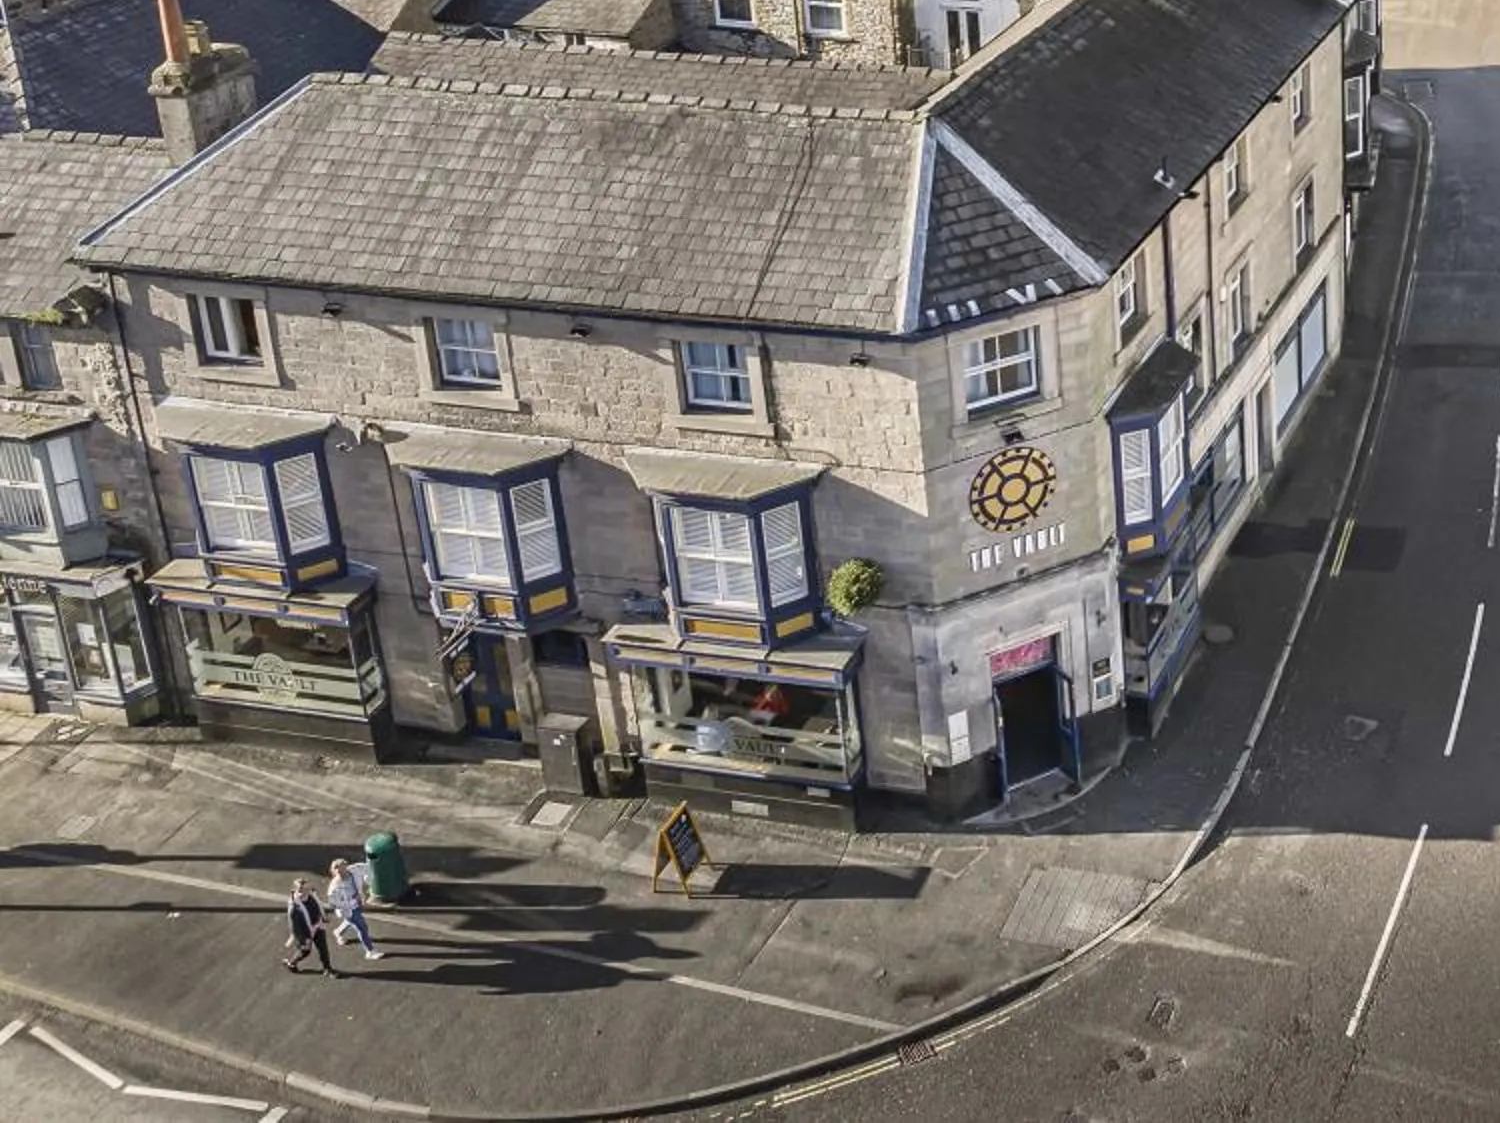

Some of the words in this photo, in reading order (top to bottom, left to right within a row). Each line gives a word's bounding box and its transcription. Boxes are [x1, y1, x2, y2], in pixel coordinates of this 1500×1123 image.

[970, 543, 1003, 574] THE
[1013, 522, 1066, 558] VAULT
[232, 670, 262, 683] THE
